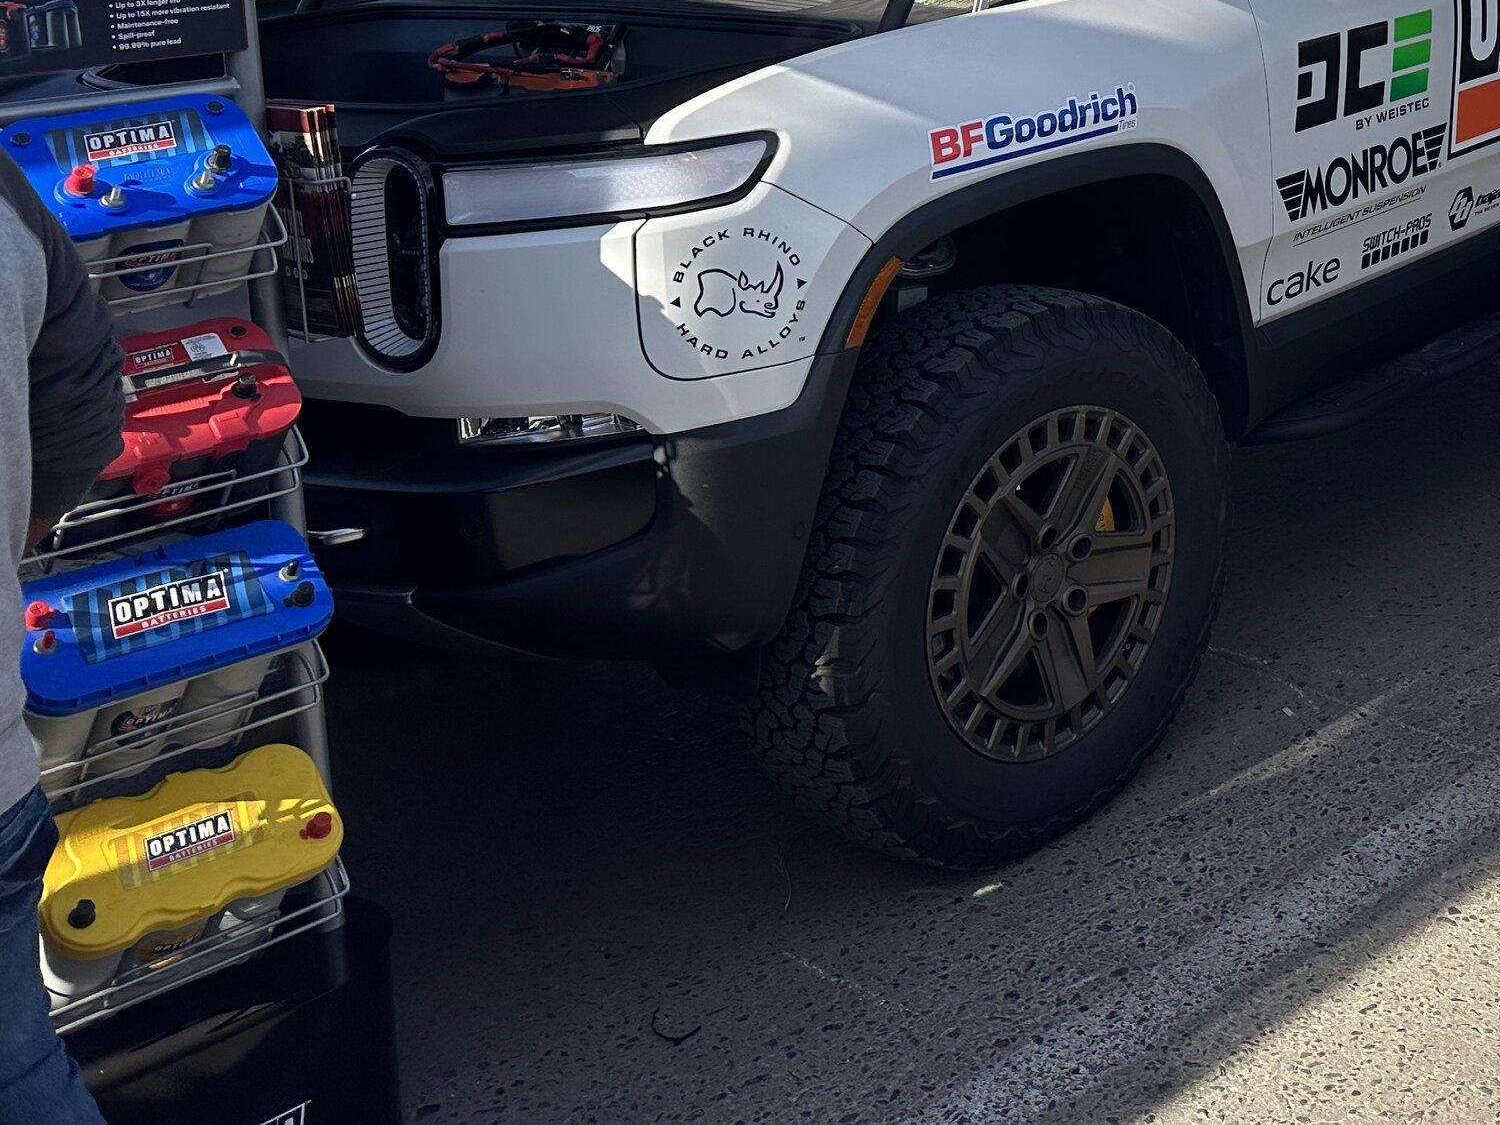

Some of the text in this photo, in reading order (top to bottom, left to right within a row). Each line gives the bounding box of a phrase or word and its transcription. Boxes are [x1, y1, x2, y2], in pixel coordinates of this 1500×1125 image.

[115, 2, 126, 10] Up
[136, 0, 146, 7] 3X
[116, 12, 127, 20] Up
[151, 8, 168, 16] more
[169, 4, 200, 14] vibration
[200, 2, 230, 11] resistant
[117, 18, 179, 30] Maintenance-free
[118, 30, 155, 41] Spill-proof
[119, 37, 182, 51] 99.99% pure lead
[930, 86, 1138, 165] BFGoodrich
[1117, 118, 1136, 131] Tires
[1356, 97, 1430, 131] BY WEISTEC
[89, 125, 171, 150] OPTIMA
[1288, 124, 1442, 220] MONROE
[1292, 185, 1427, 242] INTELLIGENT SUSPENSION
[1361, 212, 1433, 254] SWITCH-PROS
[672, 227, 801, 284] BLACK RHINO
[1266, 257, 1341, 306] cake
[676, 299, 806, 360] HARD ALLOYS
[134, 349, 172, 364] OPTIMA
[115, 577, 222, 623] OPTIMA
[141, 605, 207, 629] BATTERIES
[149, 815, 230, 856] OPTIMA
[168, 839, 218, 862] BATTERIES
